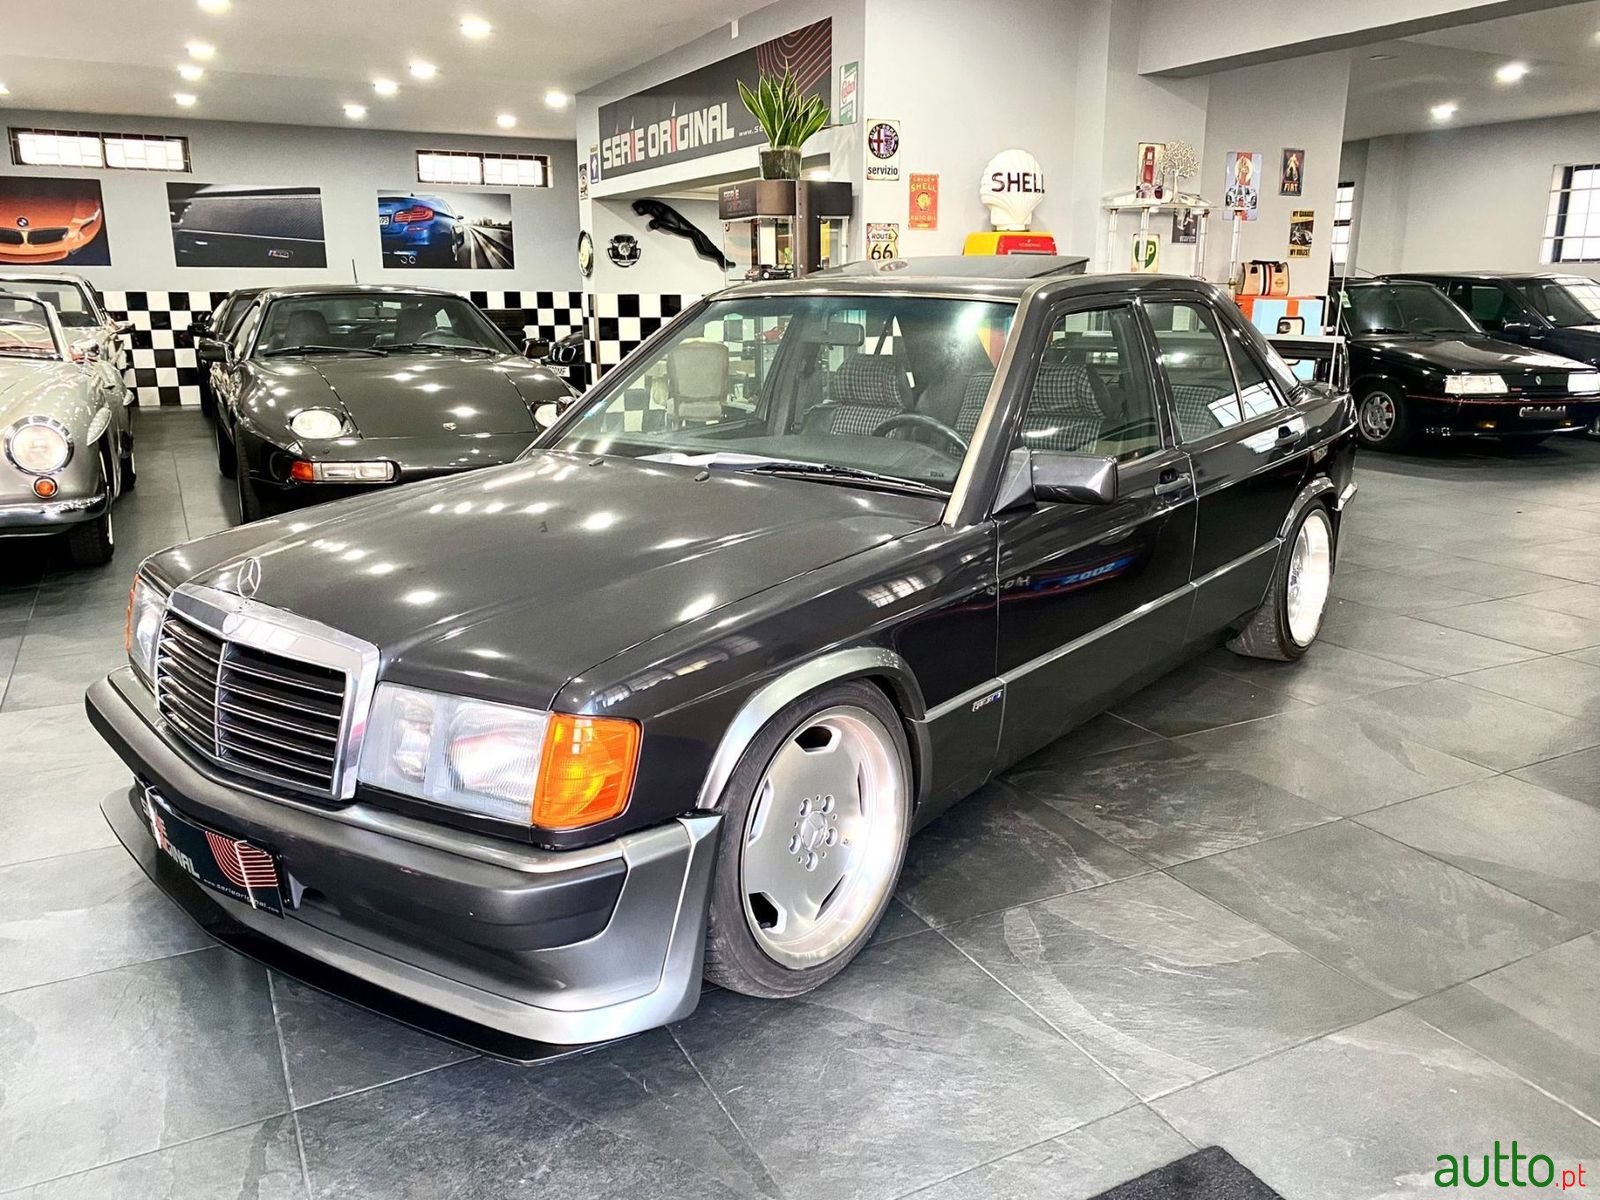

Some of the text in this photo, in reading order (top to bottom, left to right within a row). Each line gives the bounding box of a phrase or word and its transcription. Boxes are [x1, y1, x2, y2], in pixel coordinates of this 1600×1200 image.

[647, 102, 734, 158] ORIGINAL
[868, 165, 898, 175] servizio
[911, 183, 937, 193] SHELL
[991, 172, 1045, 193] SHELL
[1284, 183, 1298, 191] FIAT
[871, 243, 893, 260] 66
